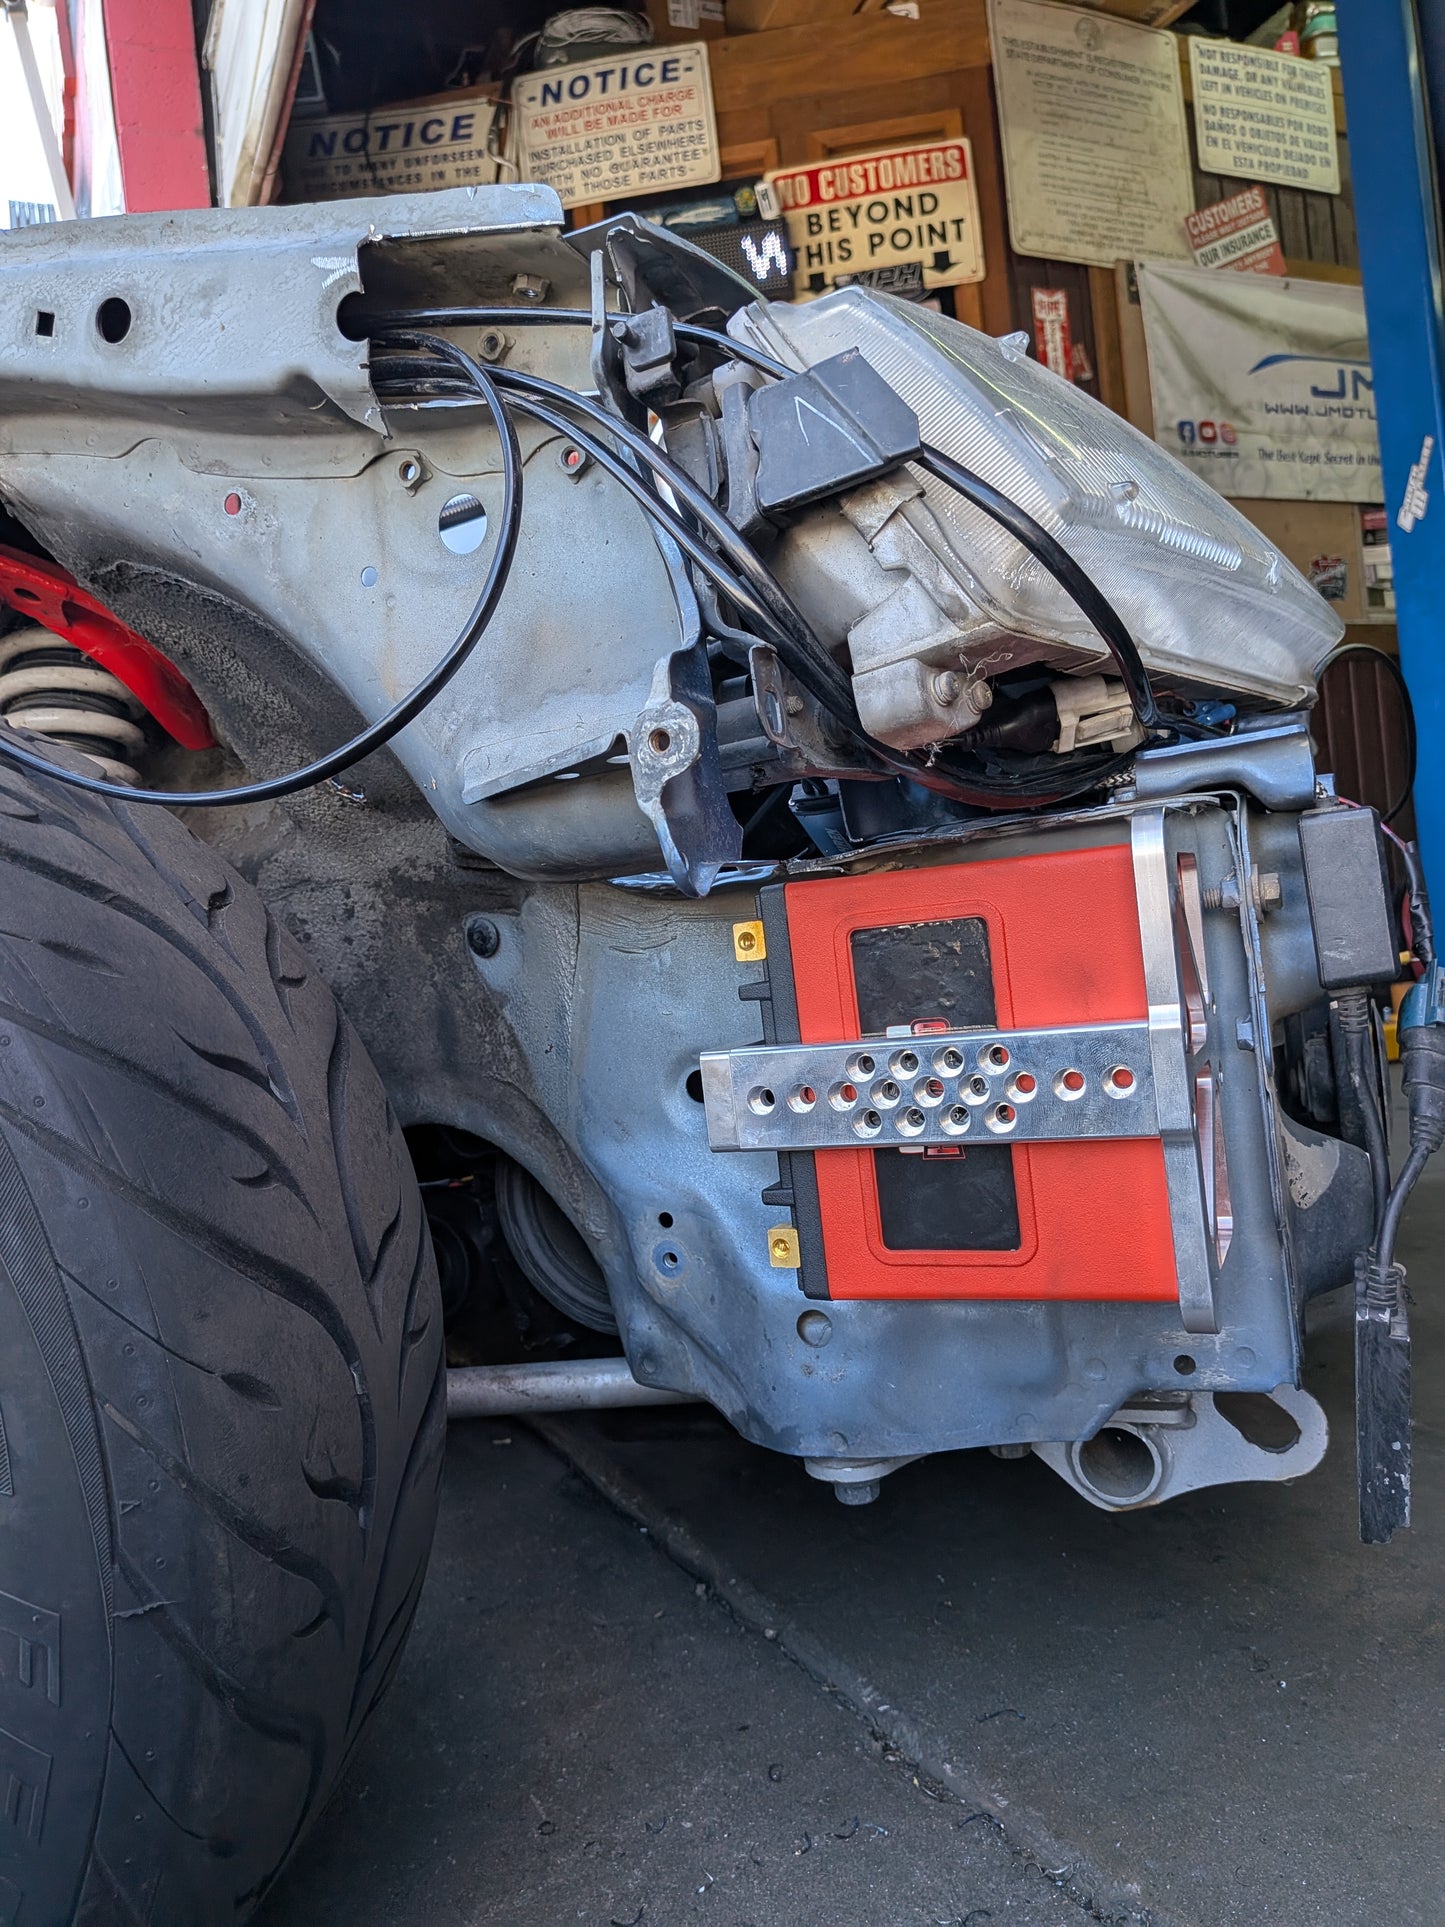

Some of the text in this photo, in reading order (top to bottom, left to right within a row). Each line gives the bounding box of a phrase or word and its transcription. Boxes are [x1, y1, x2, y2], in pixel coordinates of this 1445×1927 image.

[531, 88, 696, 130] AN ADDITIONAL CHARGE
[544, 104, 683, 140] WILL BE MADE FOR
[307, 113, 477, 158] NOTICE
[528, 119, 706, 165] INSTALLATION OF PARTS
[530, 133, 707, 177] PURCHASED ELSEWHERE
[430, 169, 446, 182] IN
[454, 165, 481, 179] THE
[532, 170, 575, 187] WITH
[581, 166, 602, 180] NO
[583, 174, 632, 195] THOSE
[775, 174, 812, 208] NO
[816, 147, 965, 201] CUSTOMERS
[806, 191, 940, 237] BEYOND
[1187, 187, 1264, 237] CUSTOMERS
[868, 217, 966, 257] POINT
[1199, 247, 1221, 268] OUR
[1219, 222, 1275, 258] INSURANCE
